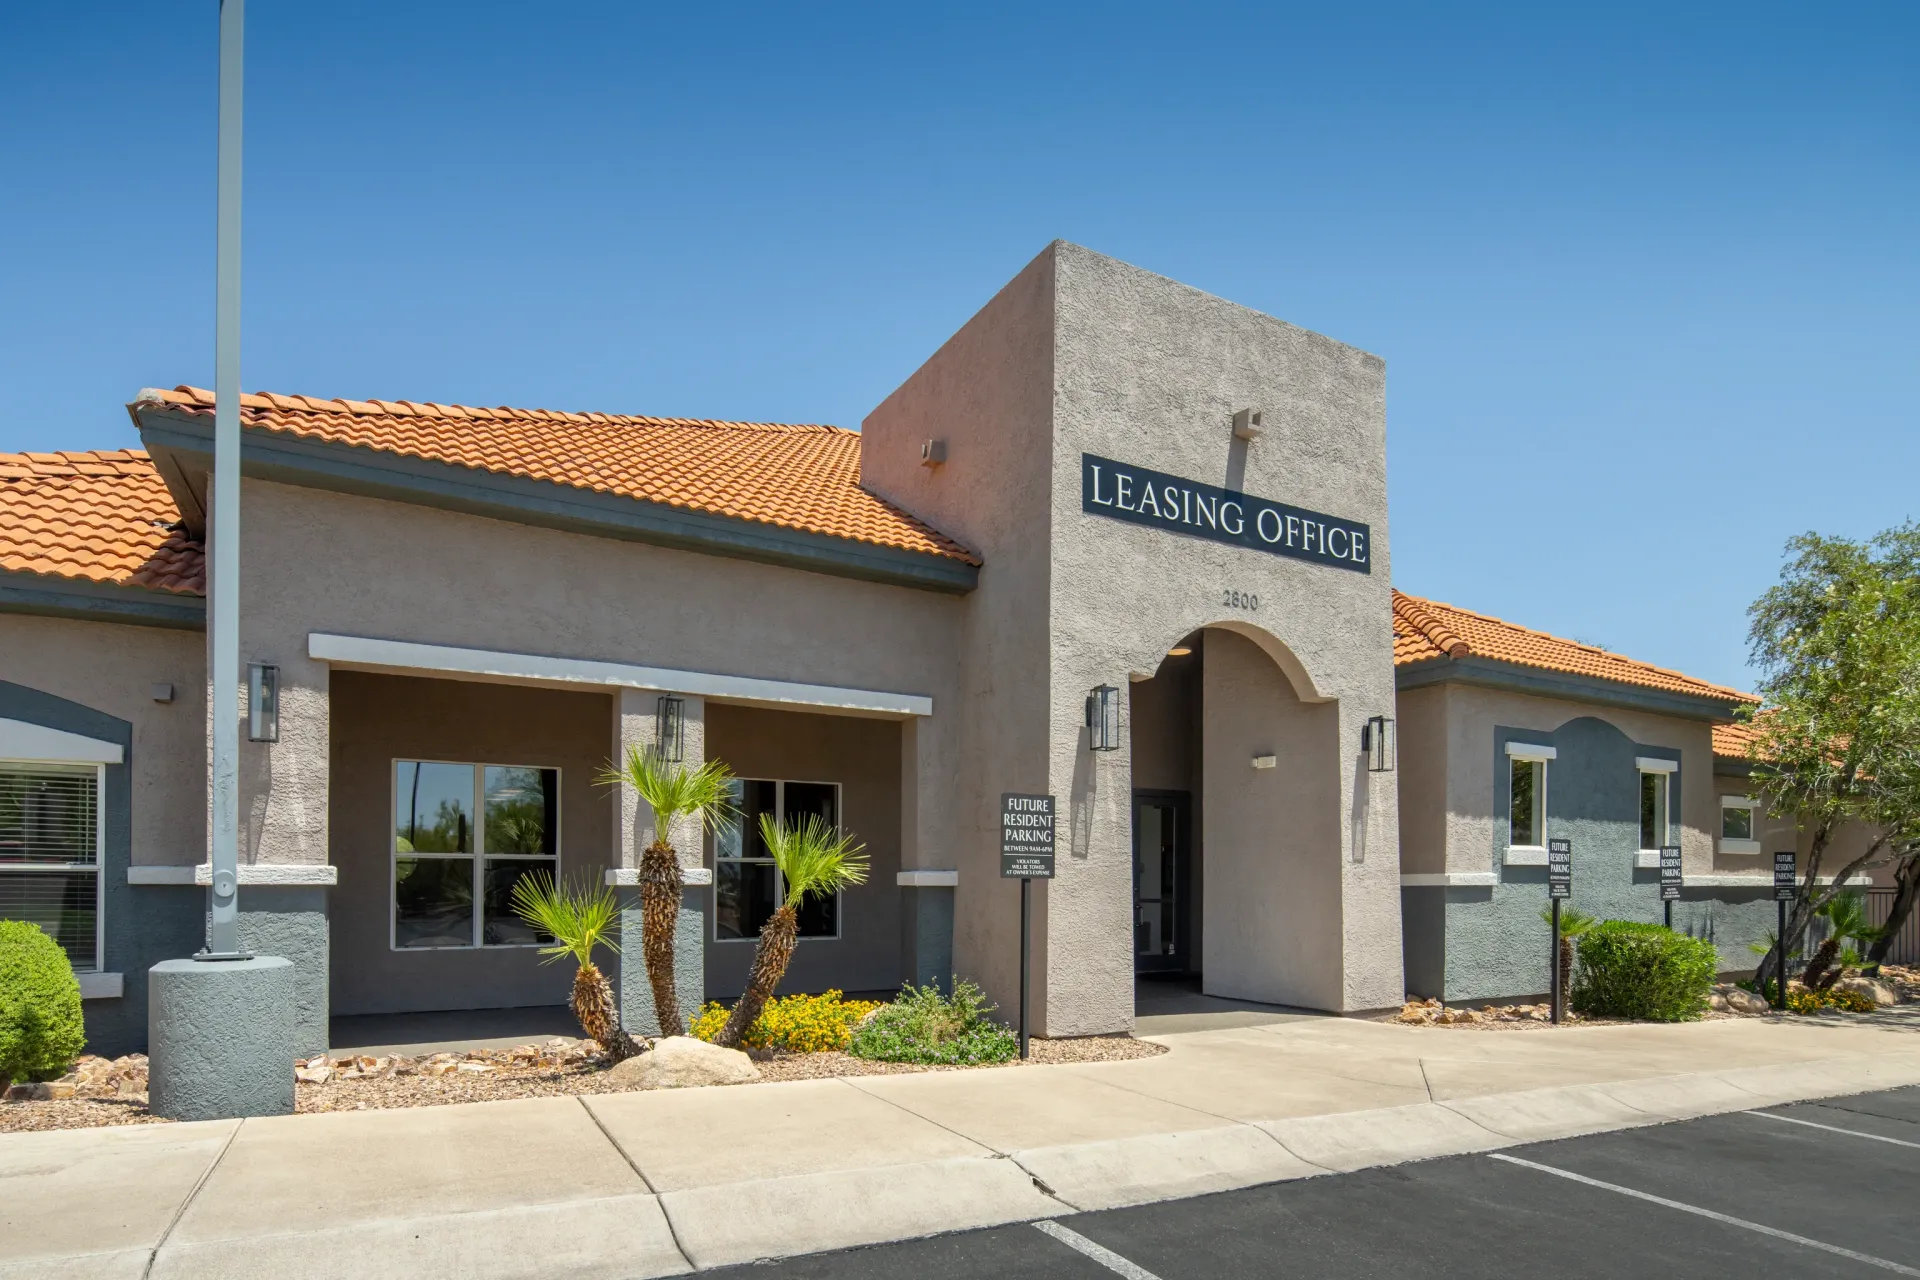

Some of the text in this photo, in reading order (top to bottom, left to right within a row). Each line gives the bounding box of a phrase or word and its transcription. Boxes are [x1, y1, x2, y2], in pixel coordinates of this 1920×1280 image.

[1091, 465, 1366, 563] LEASING OFFICE
[1008, 798, 1049, 812] FUTURE
[1004, 813, 1053, 827] RESIDENT
[1005, 828, 1052, 842] PARKING
[1551, 842, 1568, 851] FUTURE
[1550, 852, 1570, 862] RESIDENT
[1662, 848, 1680, 857] FUTURE
[1661, 858, 1681, 867] RESIDENT
[1776, 854, 1794, 862] FUTURE
[1550, 863, 1570, 873] PARKING
[1775, 863, 1795, 871] RESIDENT
[1661, 868, 1681, 877] PARKING
[1775, 872, 1795, 880] PARKING
